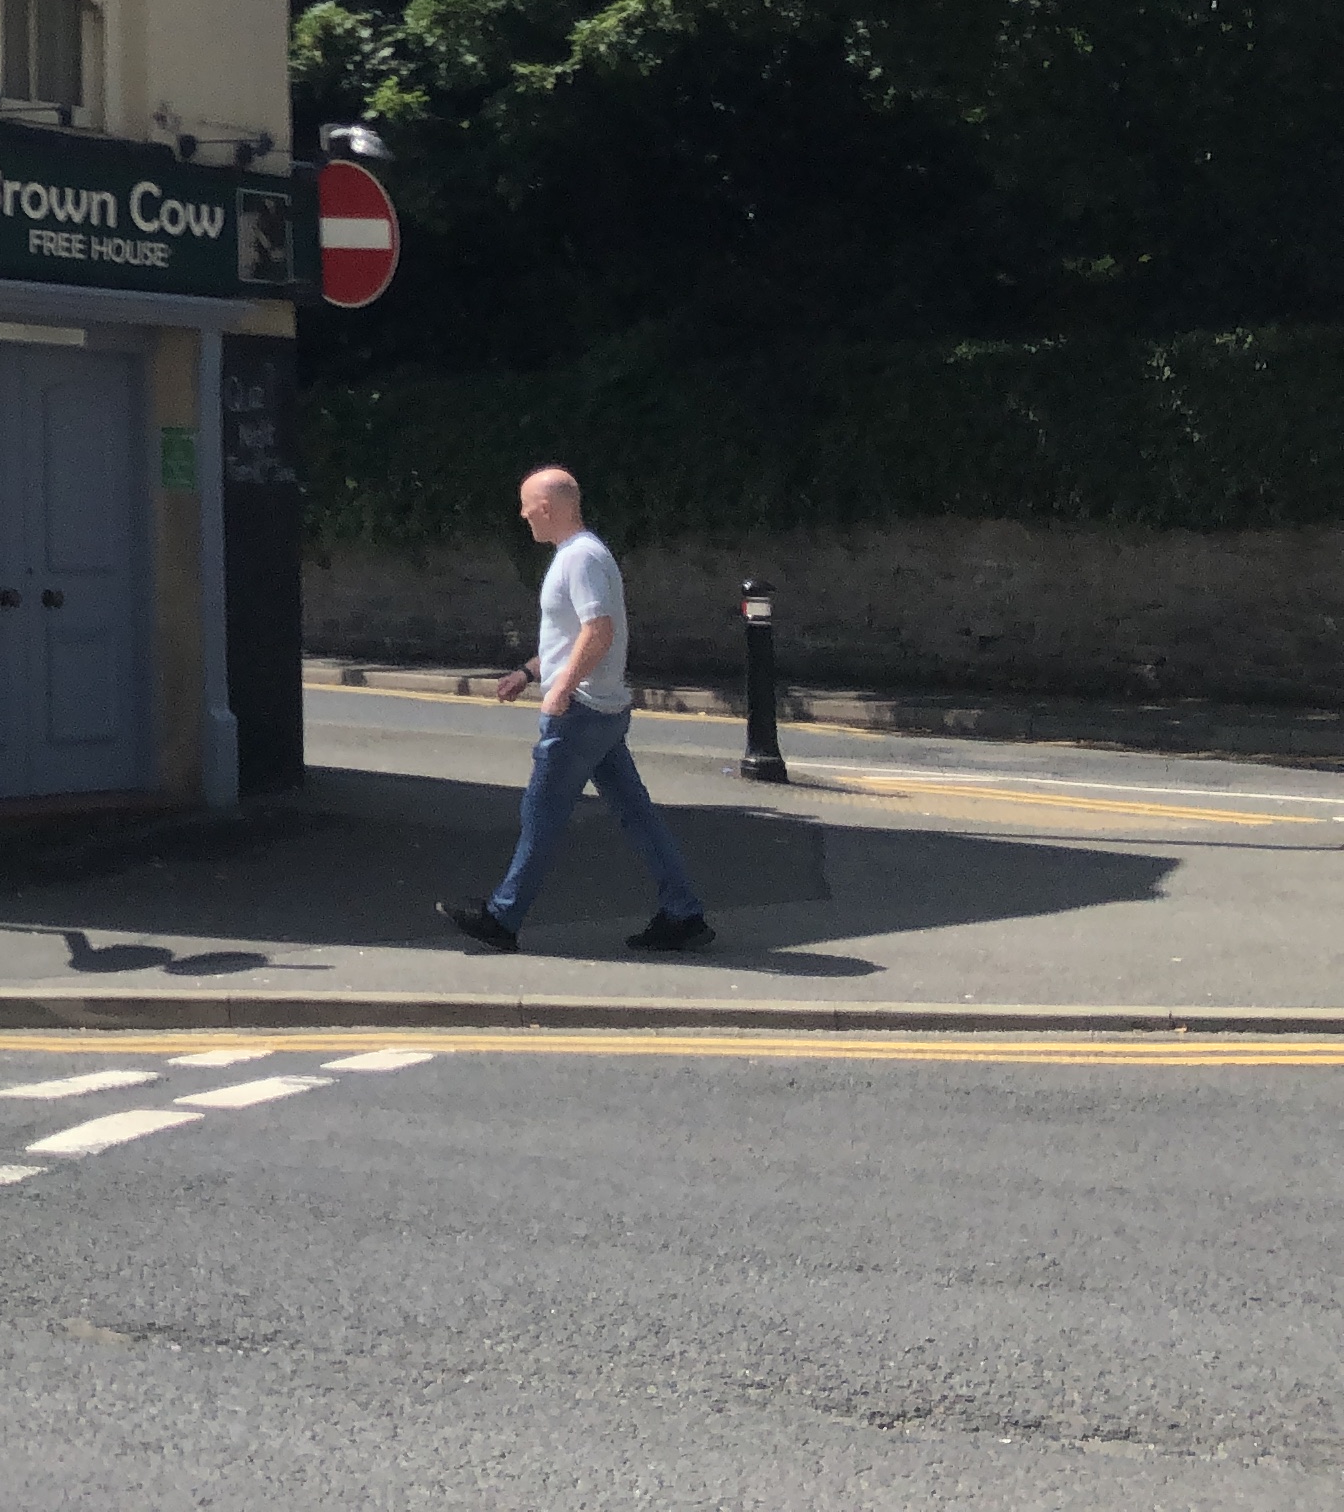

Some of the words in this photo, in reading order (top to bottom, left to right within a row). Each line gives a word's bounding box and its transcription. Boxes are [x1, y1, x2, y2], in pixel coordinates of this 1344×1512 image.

[129, 181, 225, 238] Cow
[28, 228, 88, 260] FREE
[90, 235, 170, 268] HOUSE
